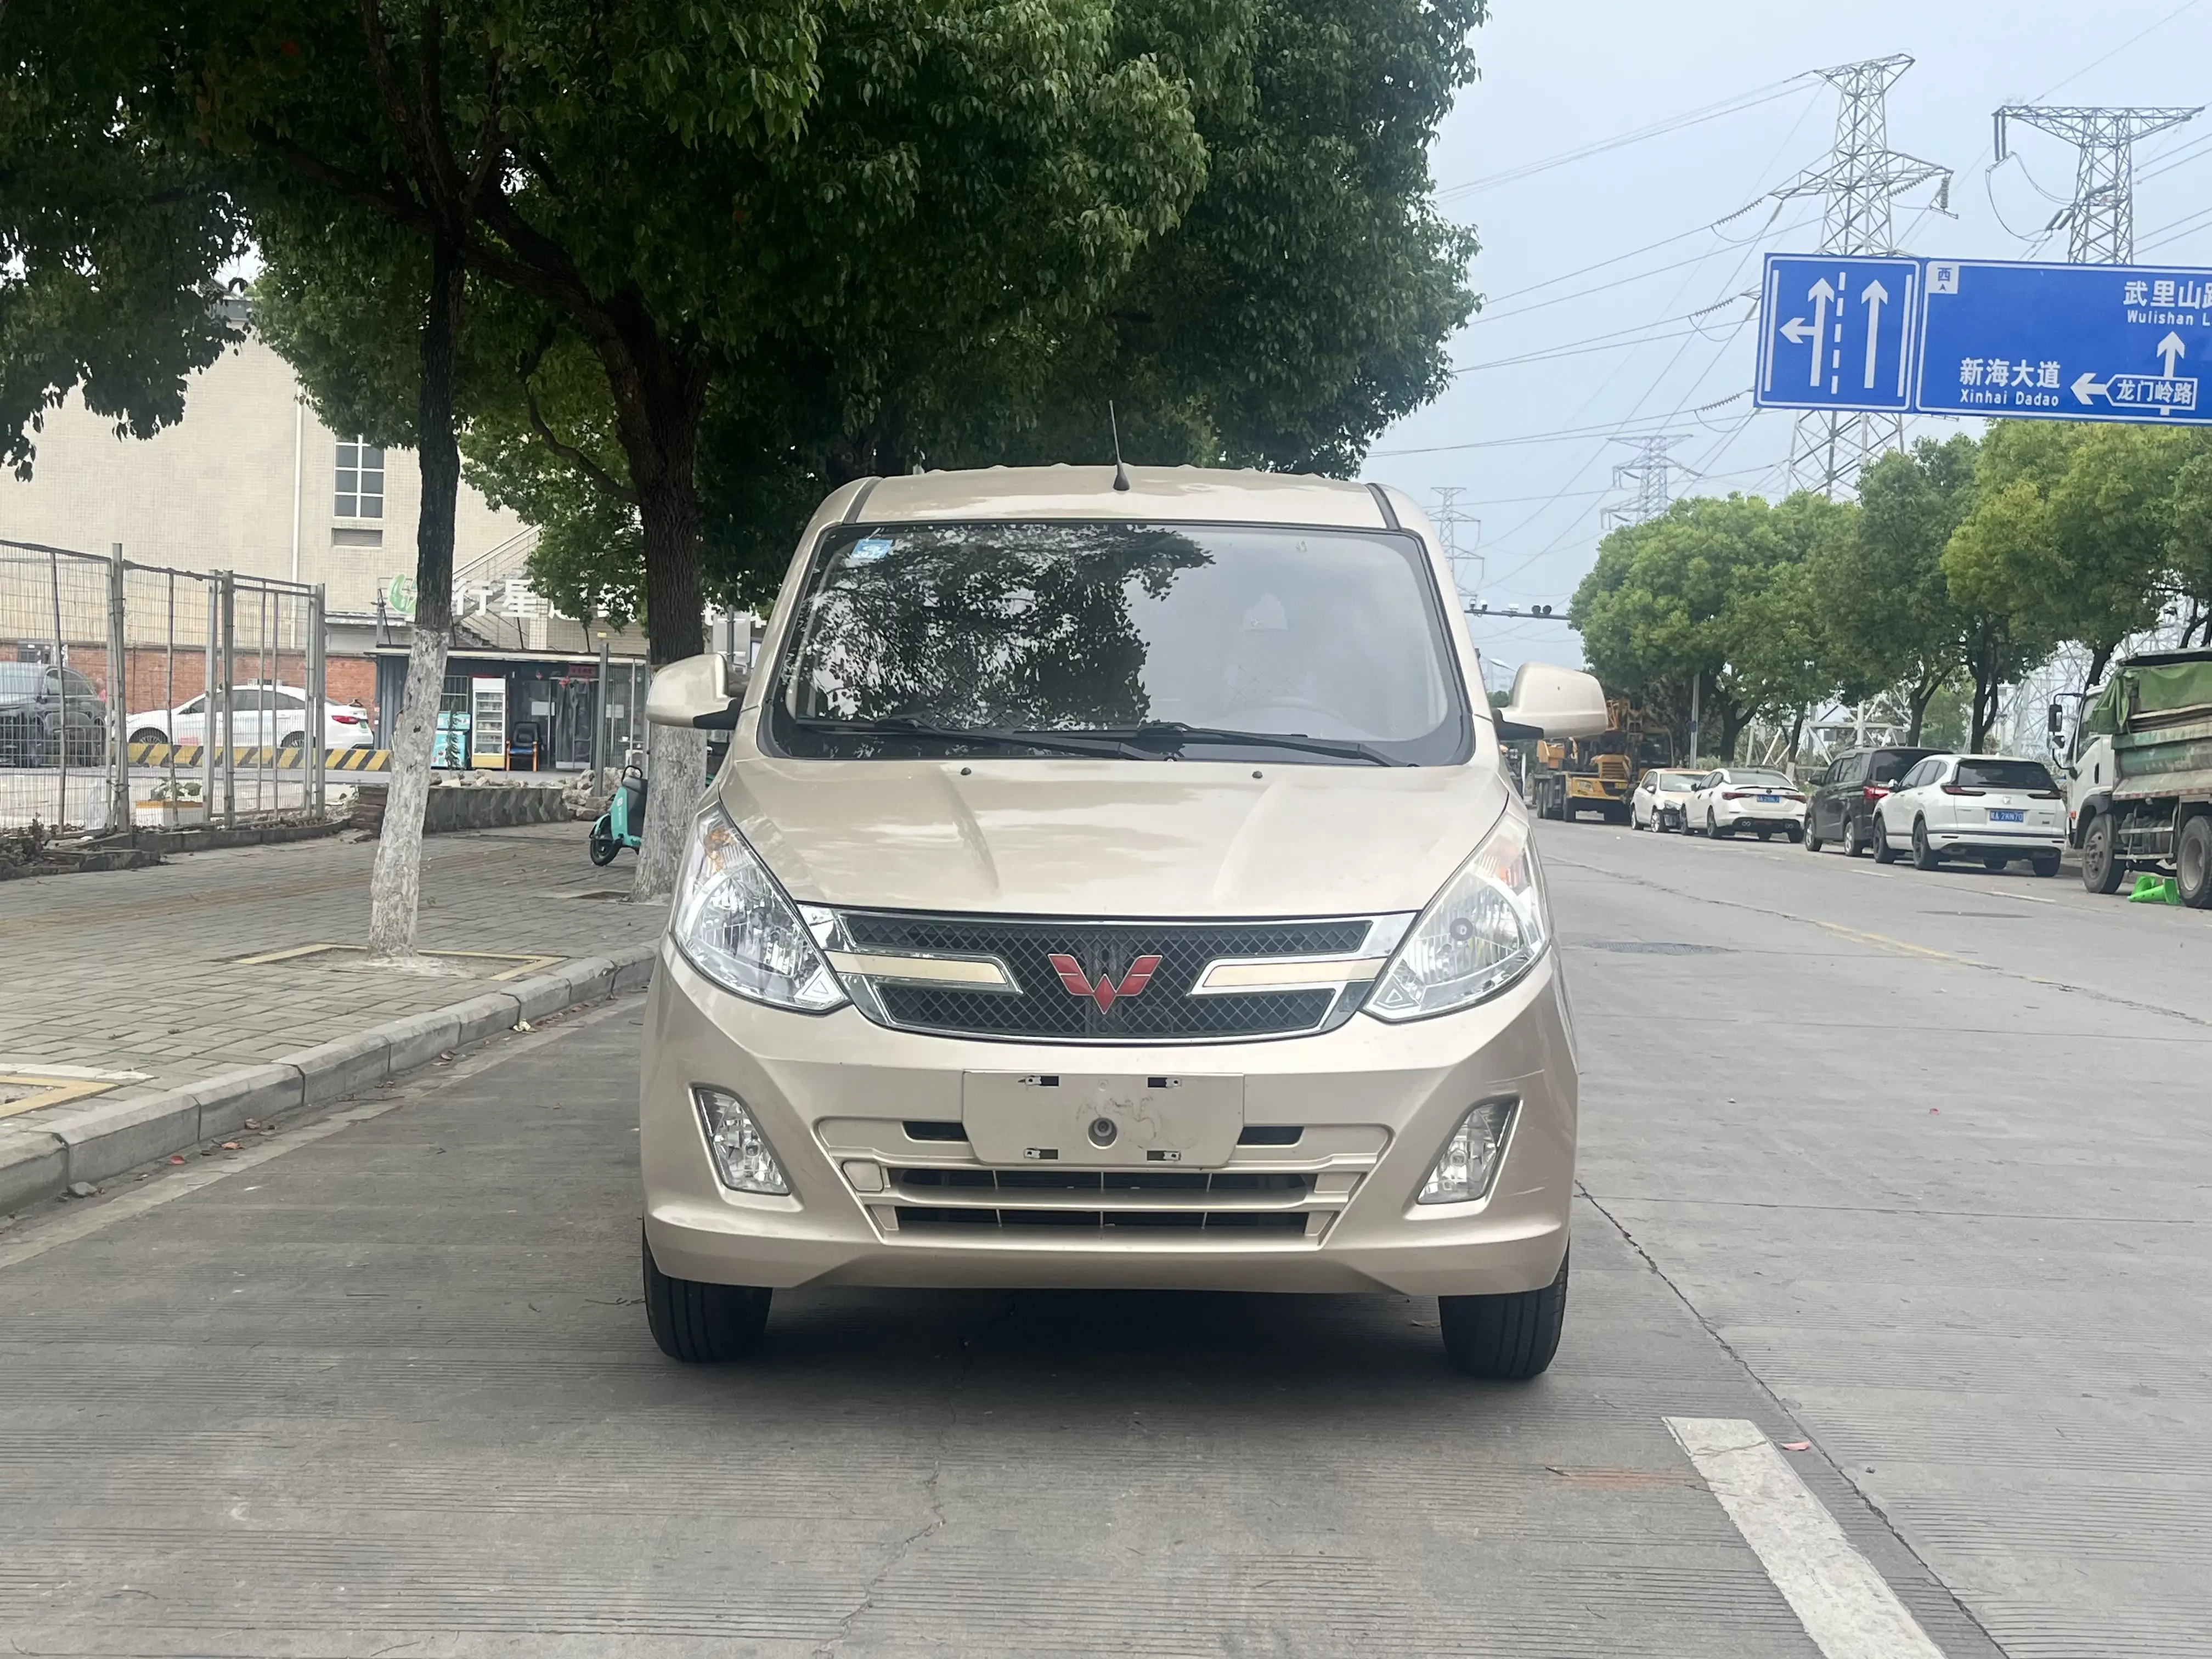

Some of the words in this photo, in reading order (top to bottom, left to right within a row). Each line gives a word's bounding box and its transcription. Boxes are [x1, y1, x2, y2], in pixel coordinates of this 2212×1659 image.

[1937, 267, 1953, 281] 西
[2128, 309, 2194, 326] Wulishan
[2202, 313, 2212, 326] L
[1959, 357, 2061, 388] 新海大道
[1960, 388, 2008, 405] Xinhai
[2015, 391, 2059, 407] Dadao
[2116, 379, 2192, 404] 龙门岭路
